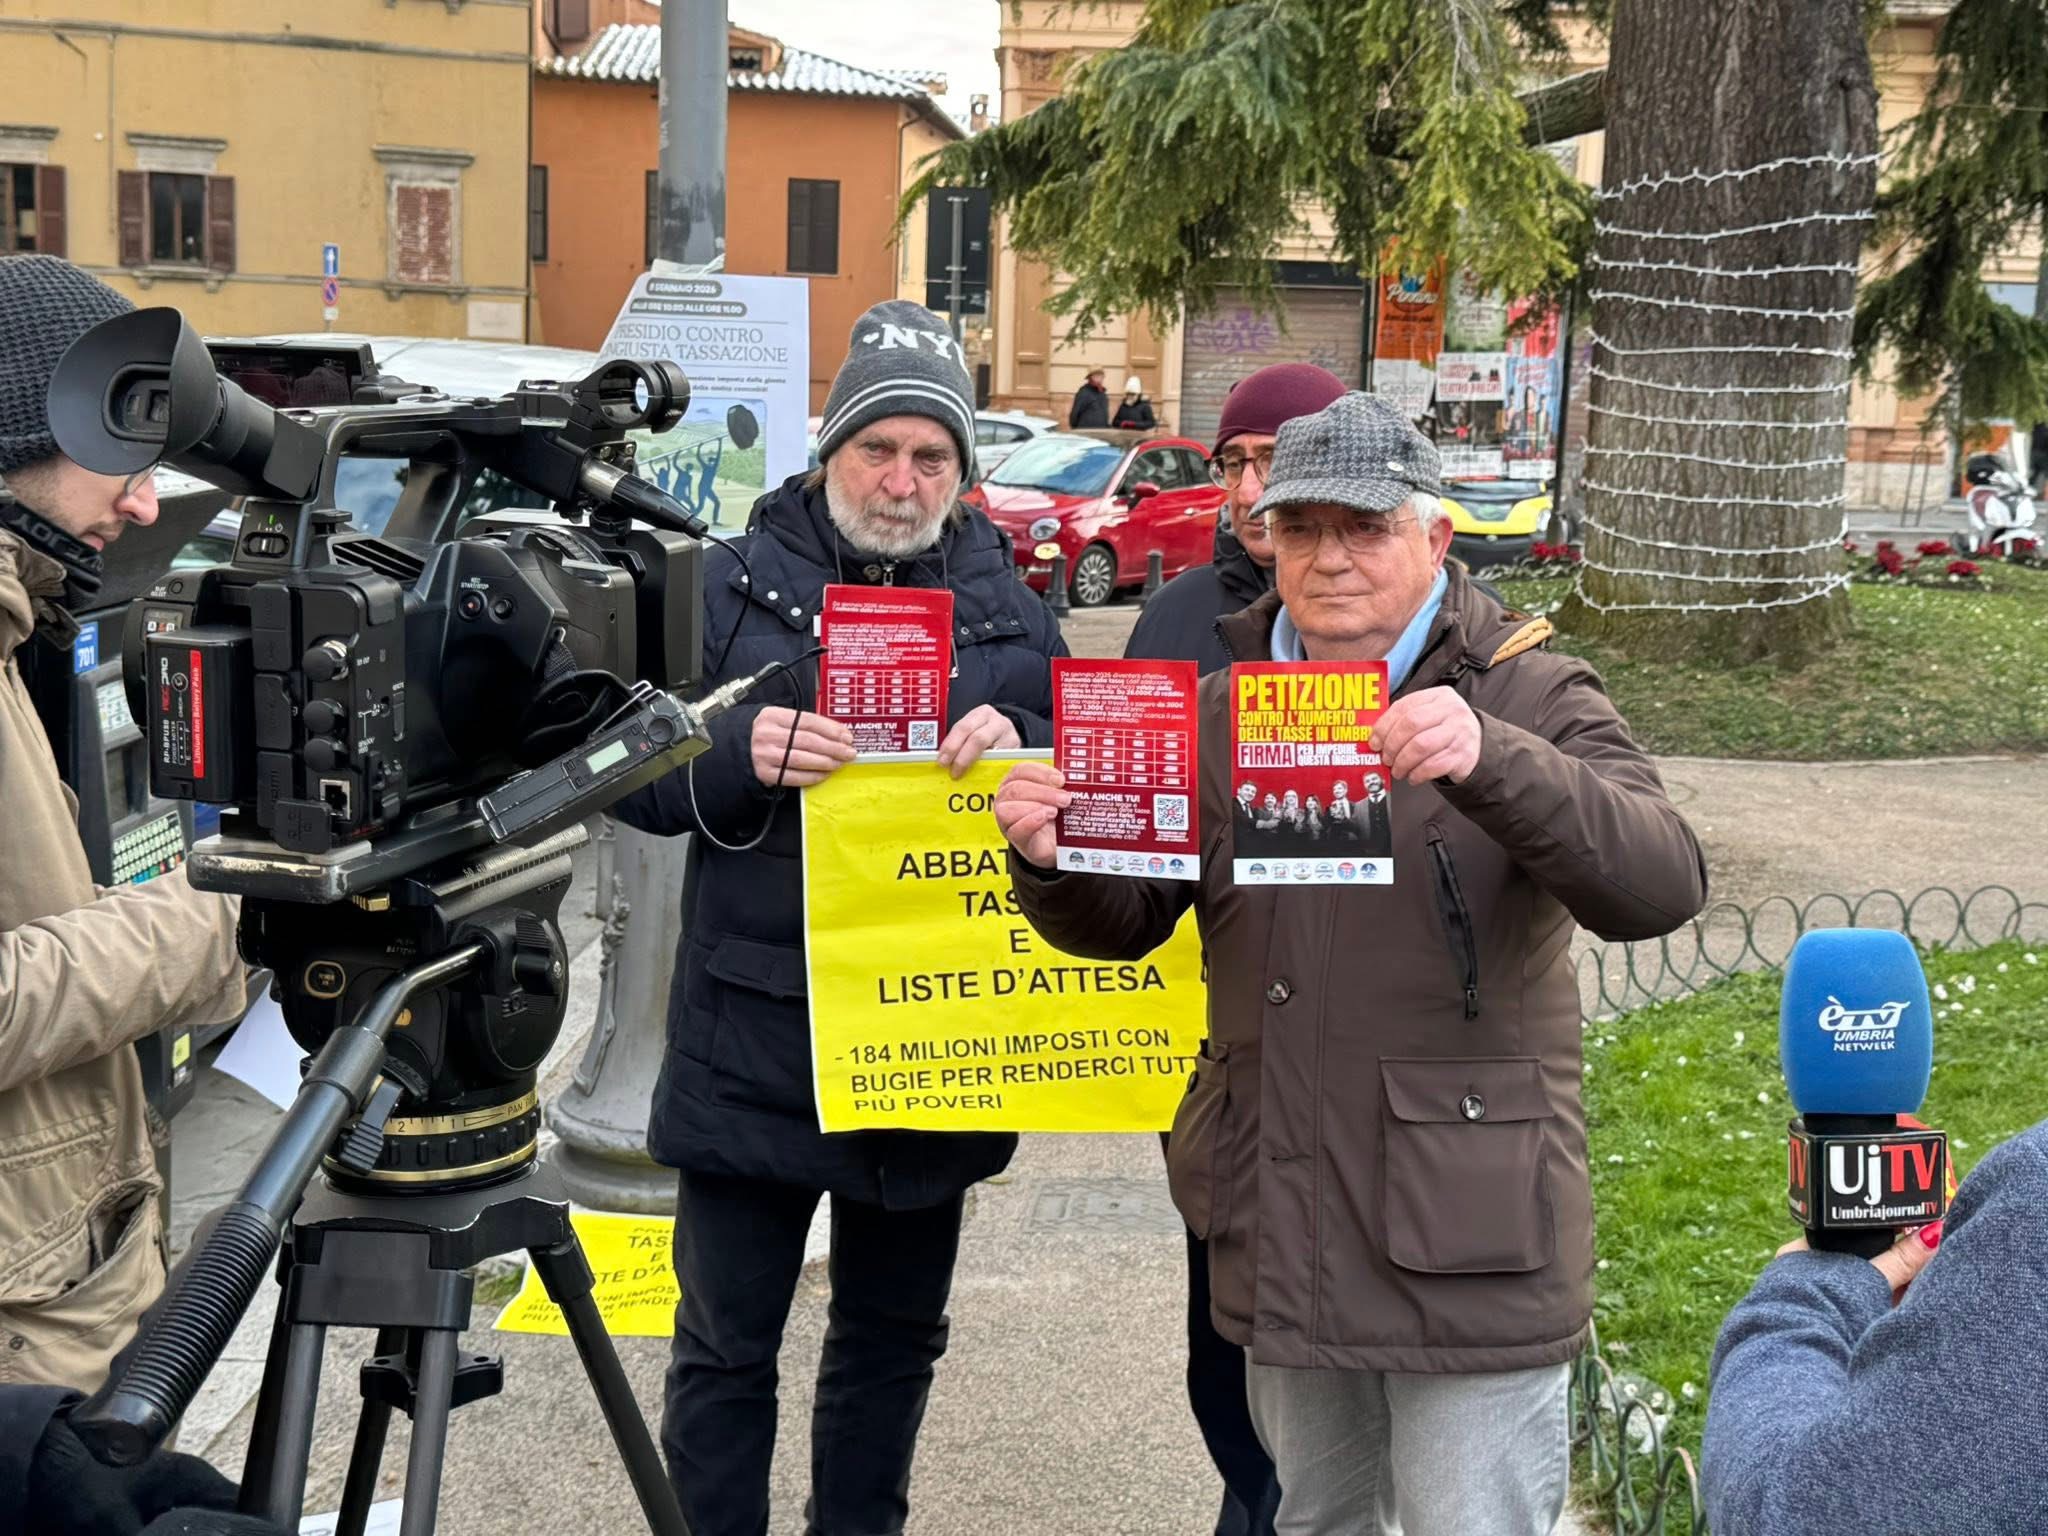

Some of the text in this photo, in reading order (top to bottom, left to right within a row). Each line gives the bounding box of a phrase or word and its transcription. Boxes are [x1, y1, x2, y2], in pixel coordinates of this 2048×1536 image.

[686, 326, 763, 344] CONTRO
[675, 343, 789, 363] TASSAZIONE
[78, 645, 94, 668] 701
[1238, 672, 1380, 710] PETIZIONE
[854, 722, 882, 730] ANCHE
[1238, 710, 1356, 726] CONTRO L'AUMENTO
[1238, 726, 1272, 742] DELLE
[1276, 726, 1313, 742] TASSE
[1316, 727, 1328, 741] IN
[1240, 744, 1293, 766] FIRMA
[1297, 744, 1314, 756] PER
[1297, 754, 1381, 766] QUESTA INGIUSTIZIA
[1092, 792, 1123, 802] ANCHE
[1124, 794, 1140, 802] TU!
[1010, 929, 1032, 954] E
[878, 964, 1166, 1004] LISTE D'ATTESA
[900, 1036, 996, 1062] MILIONI
[1005, 1030, 1108, 1054] IMPOSTI
[1116, 1028, 1170, 1047] CON
[1834, 1029, 1895, 1042] UMBRIA
[1833, 1041, 1896, 1052] NETWEEK
[851, 1070, 932, 1094] BUGIE
[942, 1066, 993, 1088] PER
[1002, 1058, 1135, 1084] RENDERCI
[854, 1093, 1002, 1112] PIÙ POVERI
[398, 1120, 405, 1133] 2
[507, 1102, 523, 1116] PAN
[1829, 1141, 1939, 1206] UjTV
[650, 1251, 664, 1262] E
